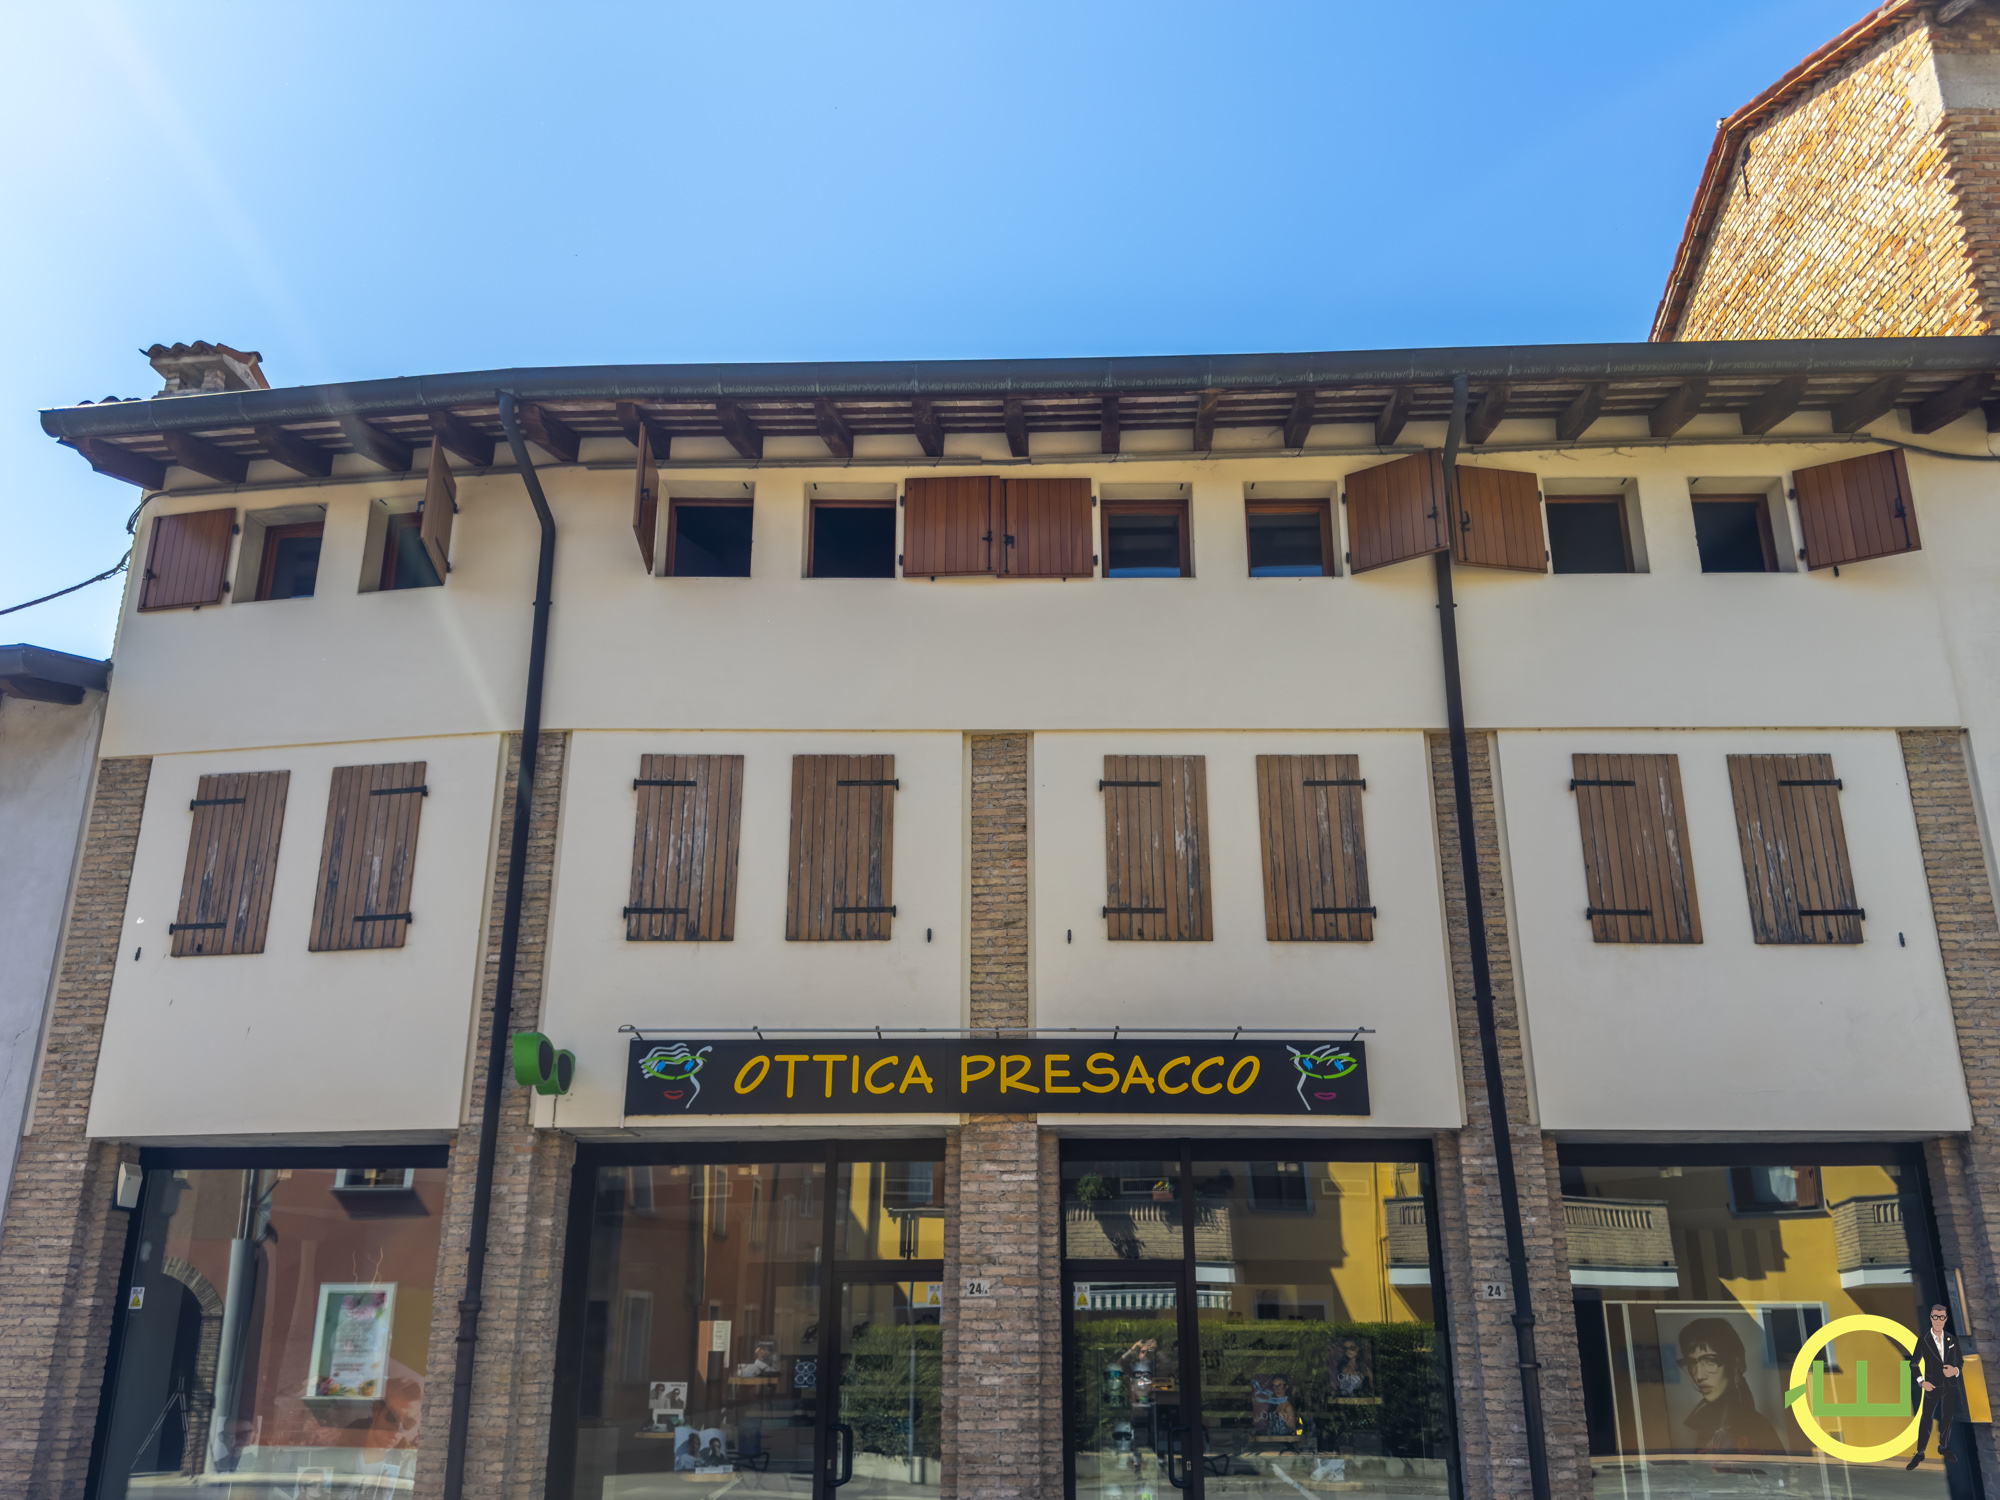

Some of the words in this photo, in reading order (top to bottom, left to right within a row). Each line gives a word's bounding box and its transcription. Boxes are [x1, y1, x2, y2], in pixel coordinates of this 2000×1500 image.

[733, 1054, 934, 1099] OTTICA
[960, 1052, 1261, 1095] PRESACCO
[1487, 1285, 1502, 1297] 24
